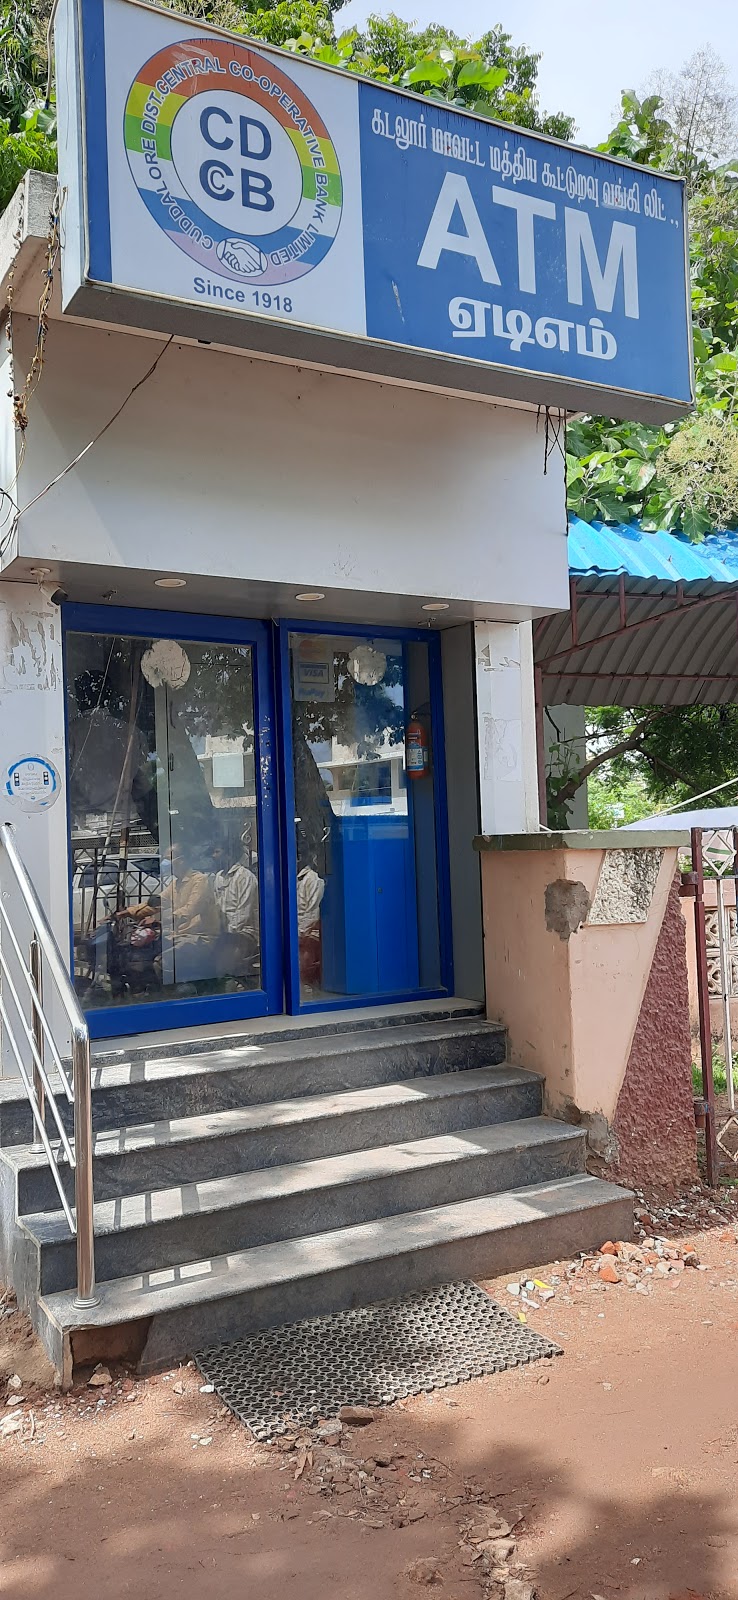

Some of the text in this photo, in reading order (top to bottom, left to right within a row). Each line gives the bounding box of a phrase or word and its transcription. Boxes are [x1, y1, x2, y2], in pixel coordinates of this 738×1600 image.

[200, 106, 272, 161] CD
[228, 60, 326, 168] CO-OPERATIVE
[371, 108, 427, 150] கடலூர்
[431, 126, 485, 168] மாவட்ட
[490, 140, 537, 184] மத்திய
[542, 165, 599, 208] கூட்டுறவு
[602, 178, 641, 214] வங்கி
[141, 137, 214, 250] CUDDALORE
[314, 172, 328, 223] BANK
[269, 223, 319, 267] LIMITED
[416, 171, 640, 320] ATM
[193, 277, 293, 313] Since 1918
[448, 296, 618, 361] ஏடிஎம்
[303, 668, 324, 677] VISA
